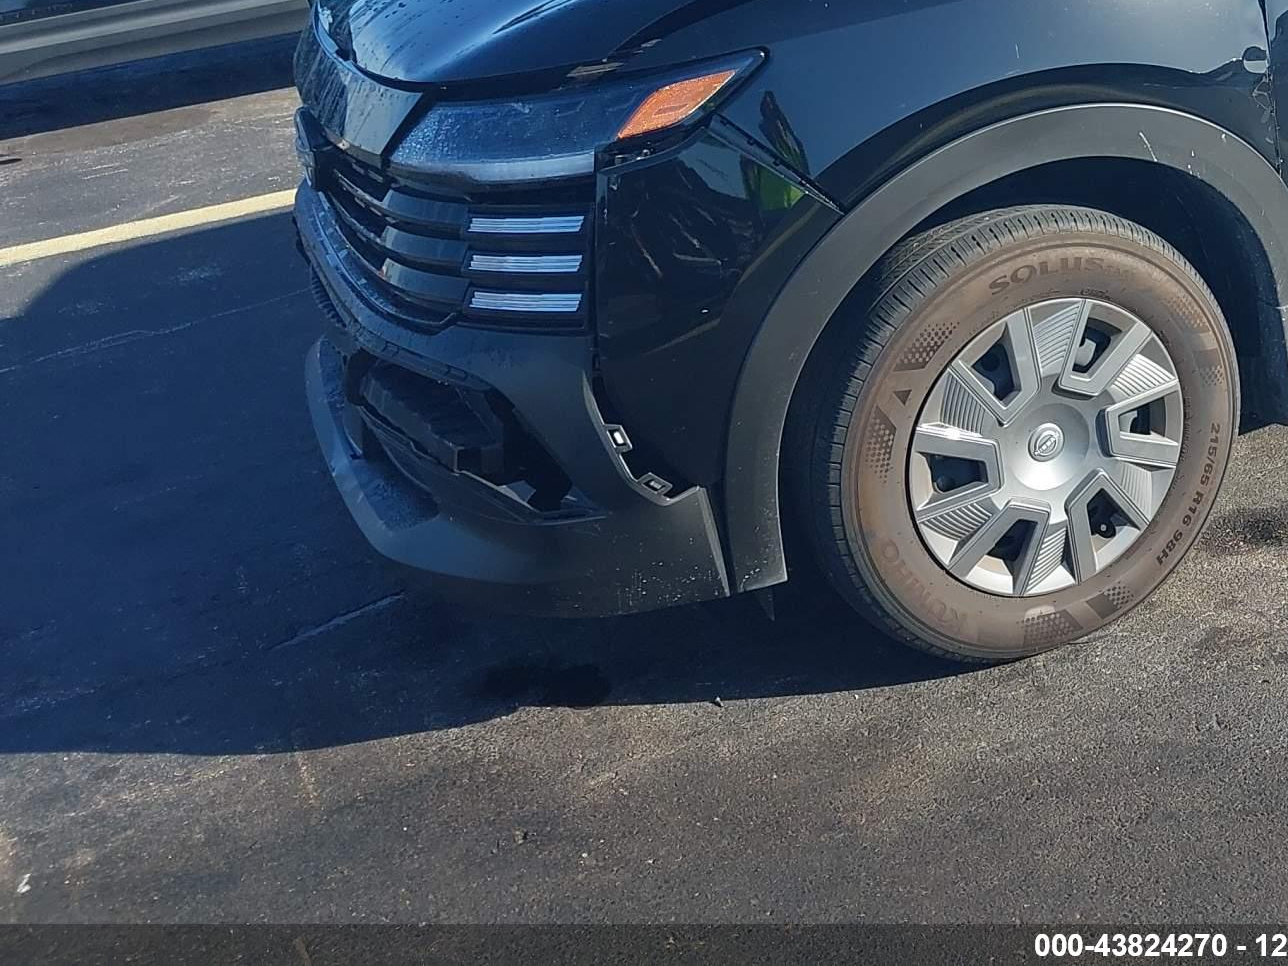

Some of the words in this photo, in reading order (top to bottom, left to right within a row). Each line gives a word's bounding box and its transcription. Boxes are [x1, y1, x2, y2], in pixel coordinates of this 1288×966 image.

[988, 256, 1105, 296] SOLUS
[1200, 422, 1221, 487] 215/65
[1182, 490, 1205, 527] R16
[1156, 529, 1184, 566] 98H
